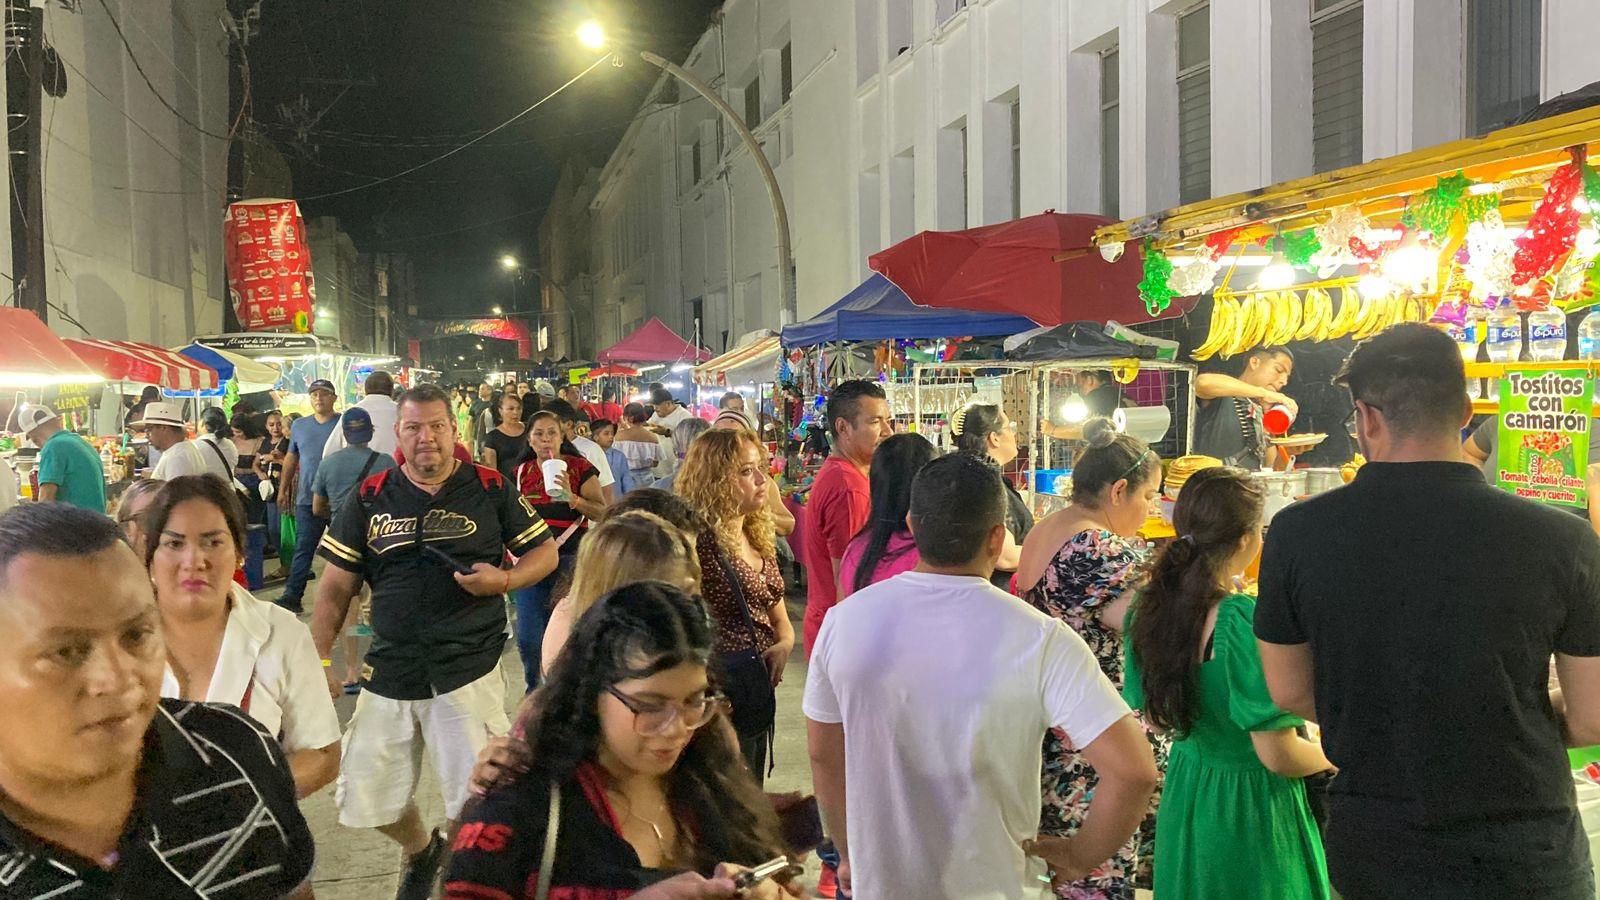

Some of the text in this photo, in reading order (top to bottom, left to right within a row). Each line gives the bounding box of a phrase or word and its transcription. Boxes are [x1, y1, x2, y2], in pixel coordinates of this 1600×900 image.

[1510, 373, 1584, 395] Tostitos
[1528, 396, 1562, 412] con
[1505, 409, 1587, 432] camarón
